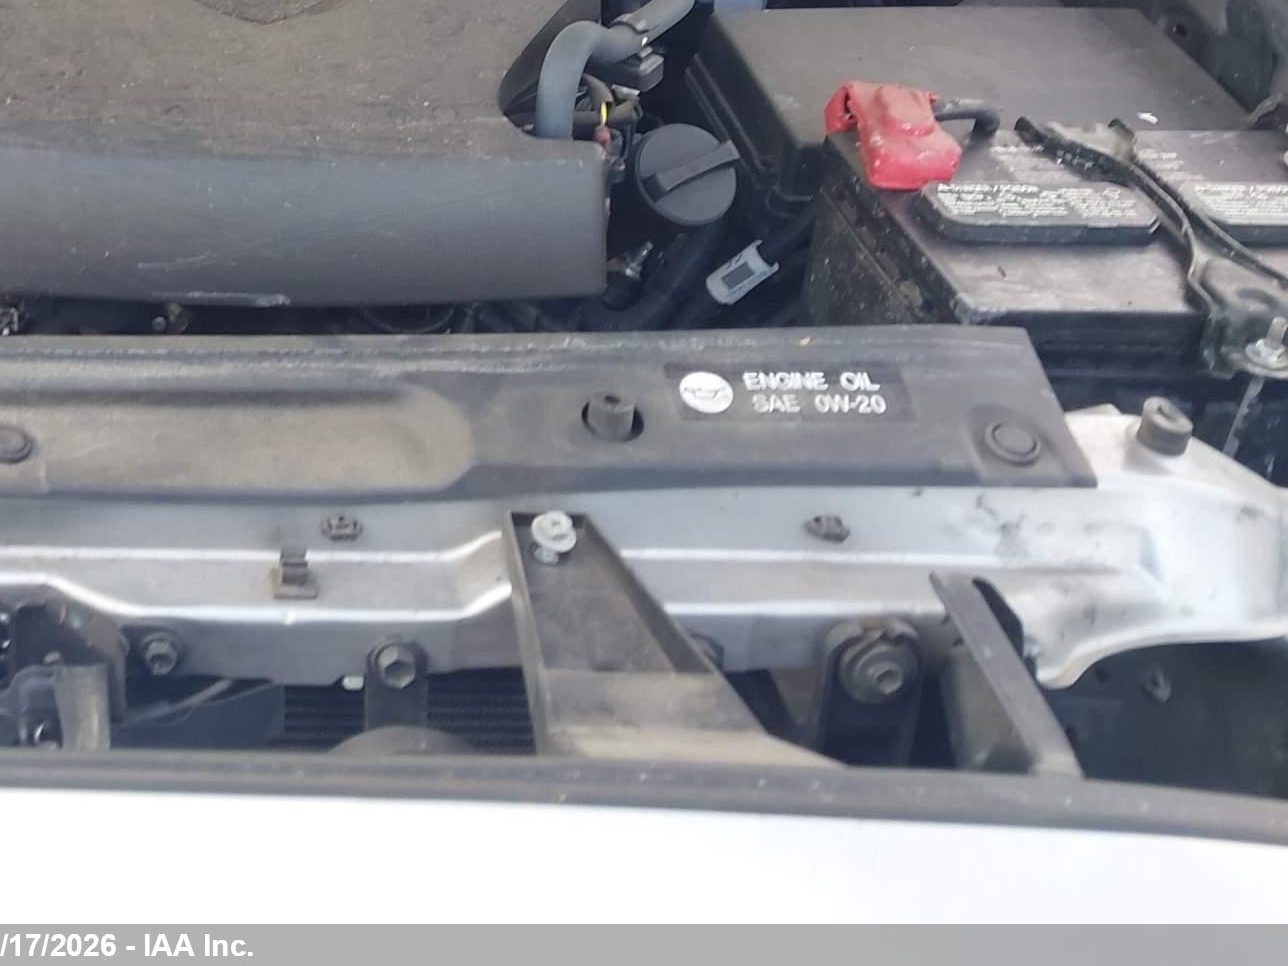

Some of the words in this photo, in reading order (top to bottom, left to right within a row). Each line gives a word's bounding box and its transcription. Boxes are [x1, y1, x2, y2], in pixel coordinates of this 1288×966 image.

[742, 371, 829, 391] ENGINE
[839, 371, 881, 392] OIL
[752, 394, 801, 413] SAE
[814, 393, 887, 414] 0W-20
